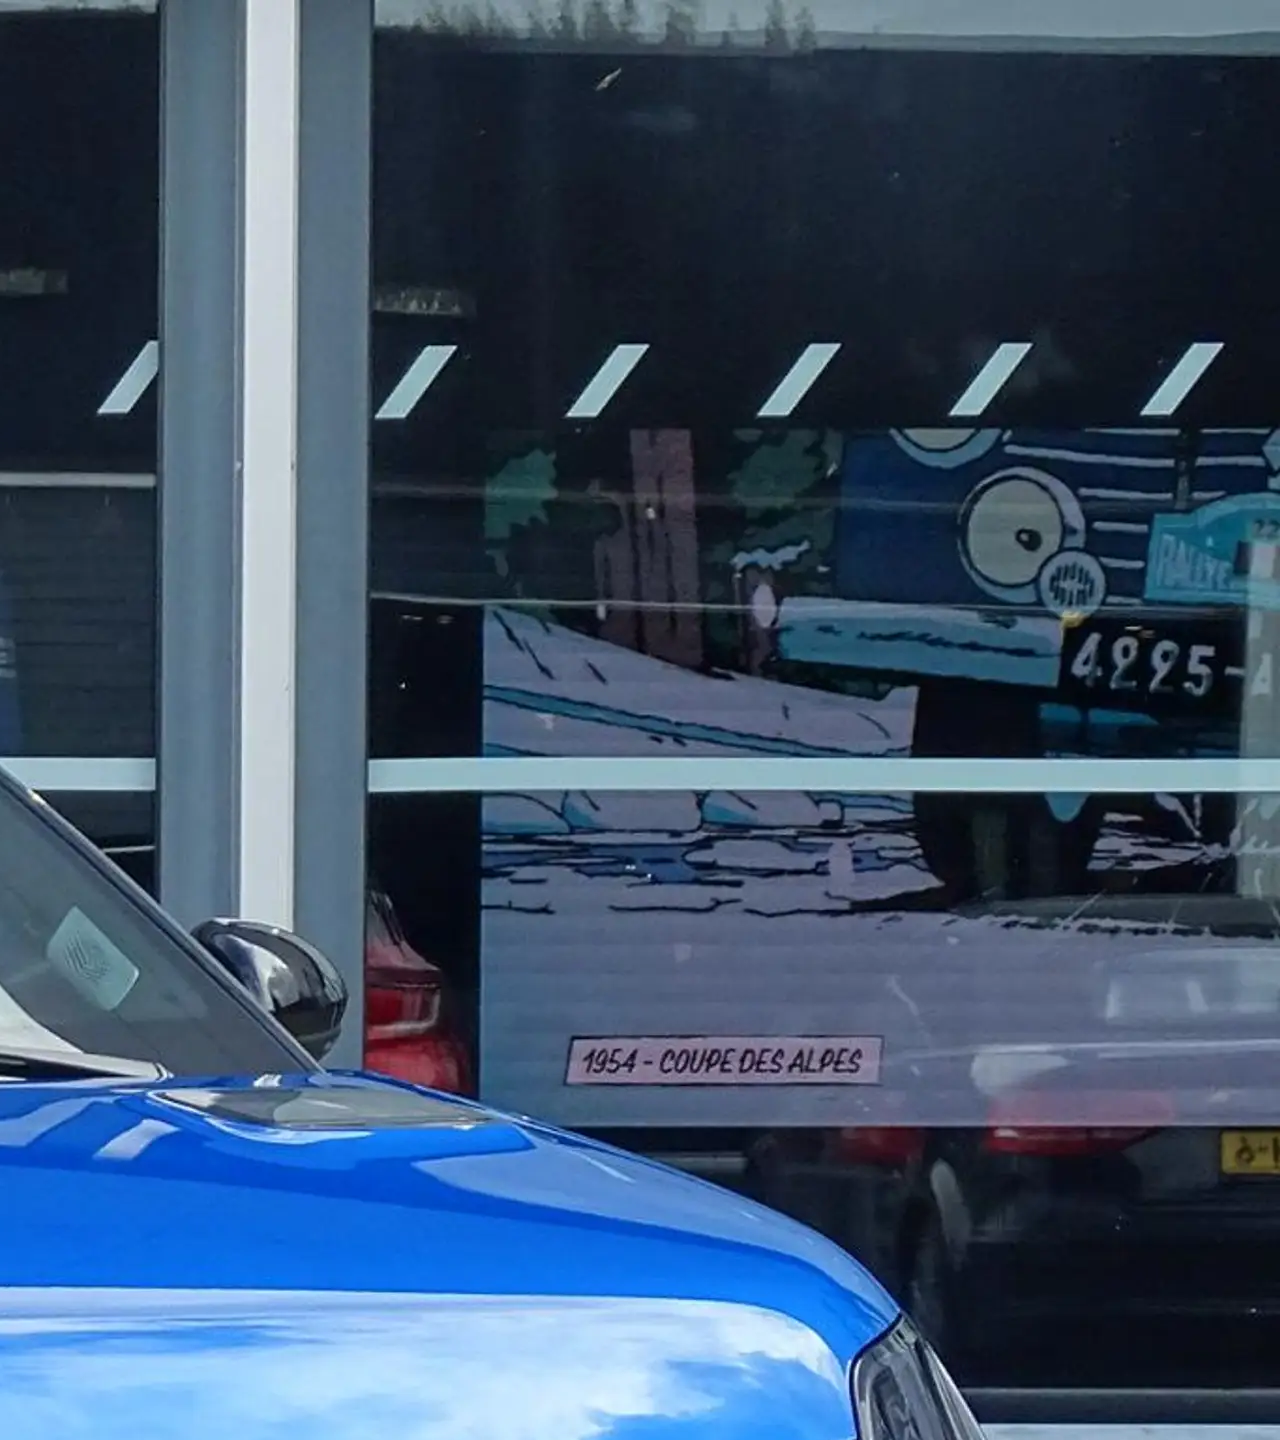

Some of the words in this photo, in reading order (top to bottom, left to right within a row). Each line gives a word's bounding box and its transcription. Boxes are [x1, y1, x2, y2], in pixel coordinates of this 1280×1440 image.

[582, 1048, 638, 1074] 1954
[659, 1049, 736, 1074] COUPE
[739, 1049, 785, 1074] DES
[789, 1049, 863, 1074] ALPES
